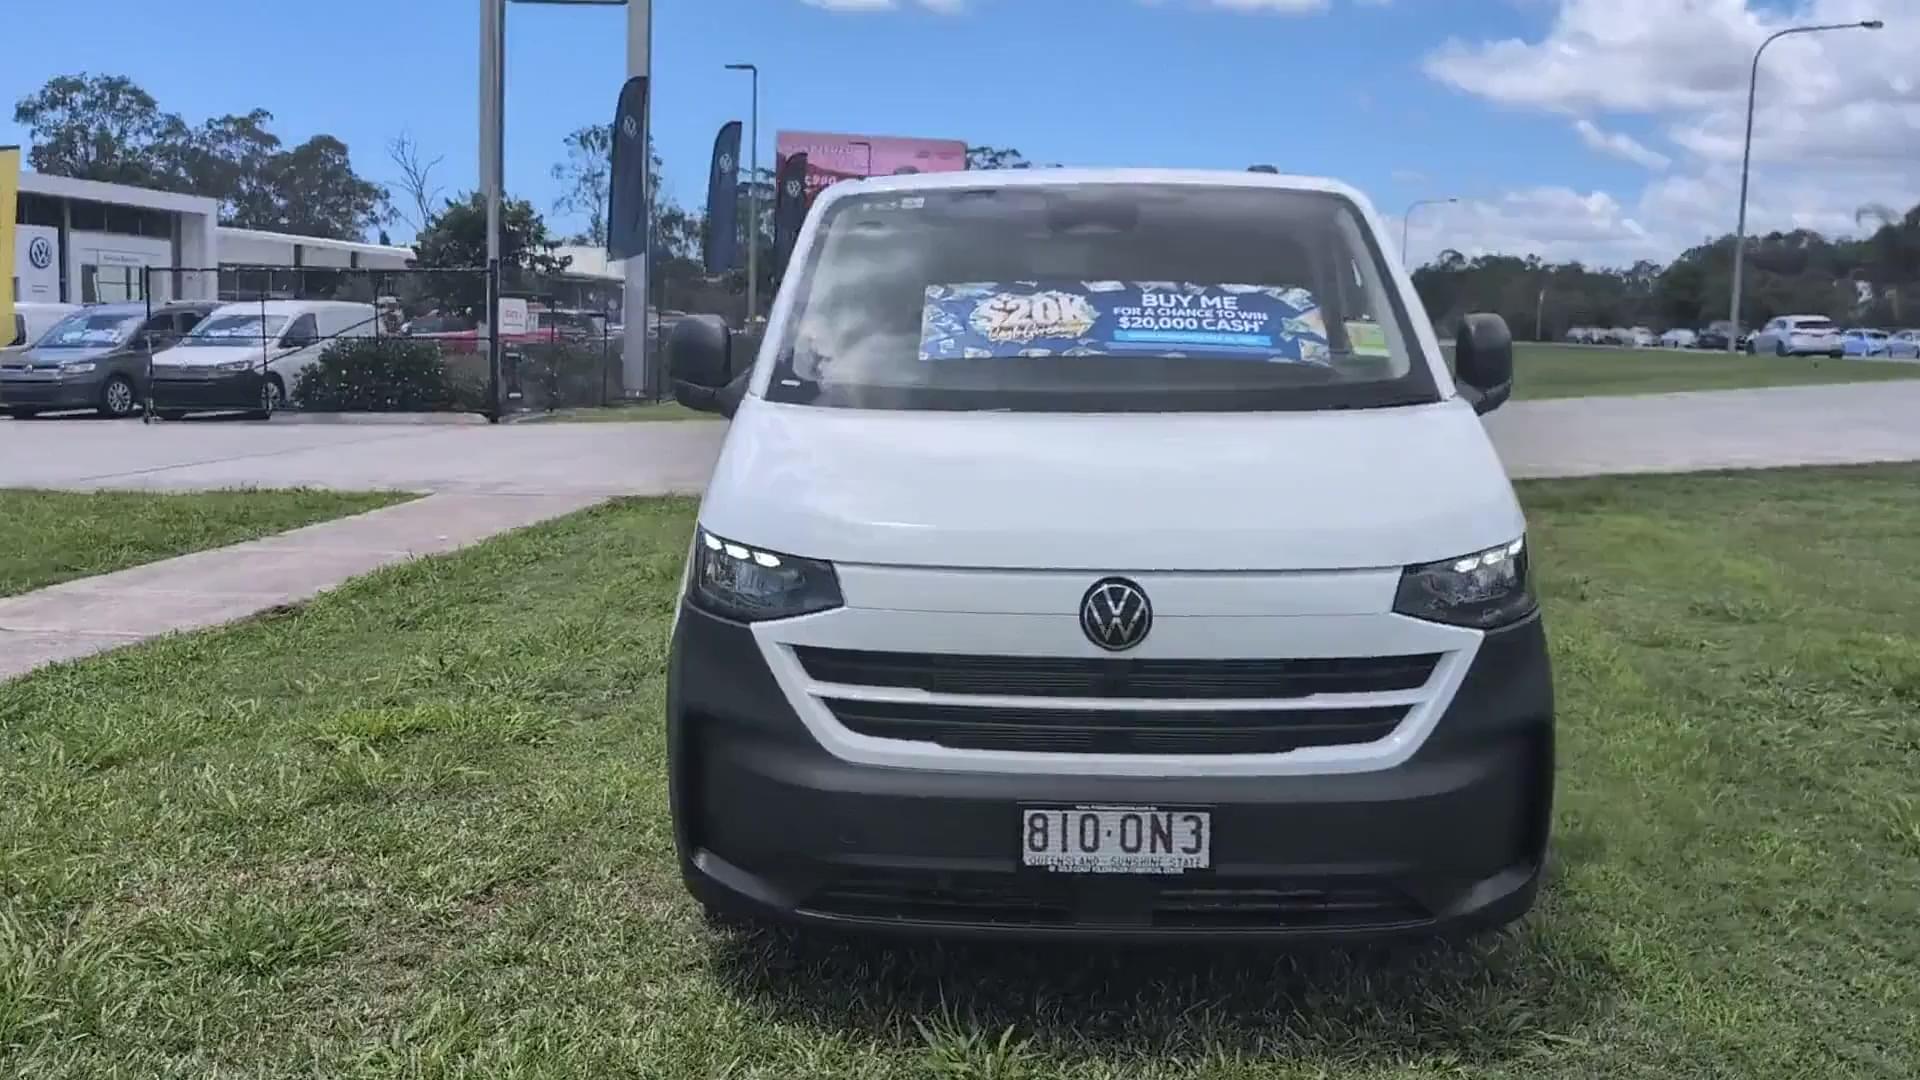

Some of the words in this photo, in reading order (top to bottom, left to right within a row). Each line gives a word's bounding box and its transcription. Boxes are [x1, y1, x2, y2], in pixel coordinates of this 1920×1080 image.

[1142, 293, 1193, 308] BUY
[1199, 295, 1239, 310] ME
[1113, 307, 1142, 316] FOR
[1143, 307, 1156, 317] A
[1156, 308, 1214, 318] CHANCE
[1215, 309, 1236, 319] TO
[1238, 311, 1269, 321] WIN
[1118, 316, 1198, 331] $20,000
[1030, 855, 1099, 866] QUEENSLAND
[1111, 856, 1162, 867] SUNSHINE
[1171, 857, 1202, 868] STATE
